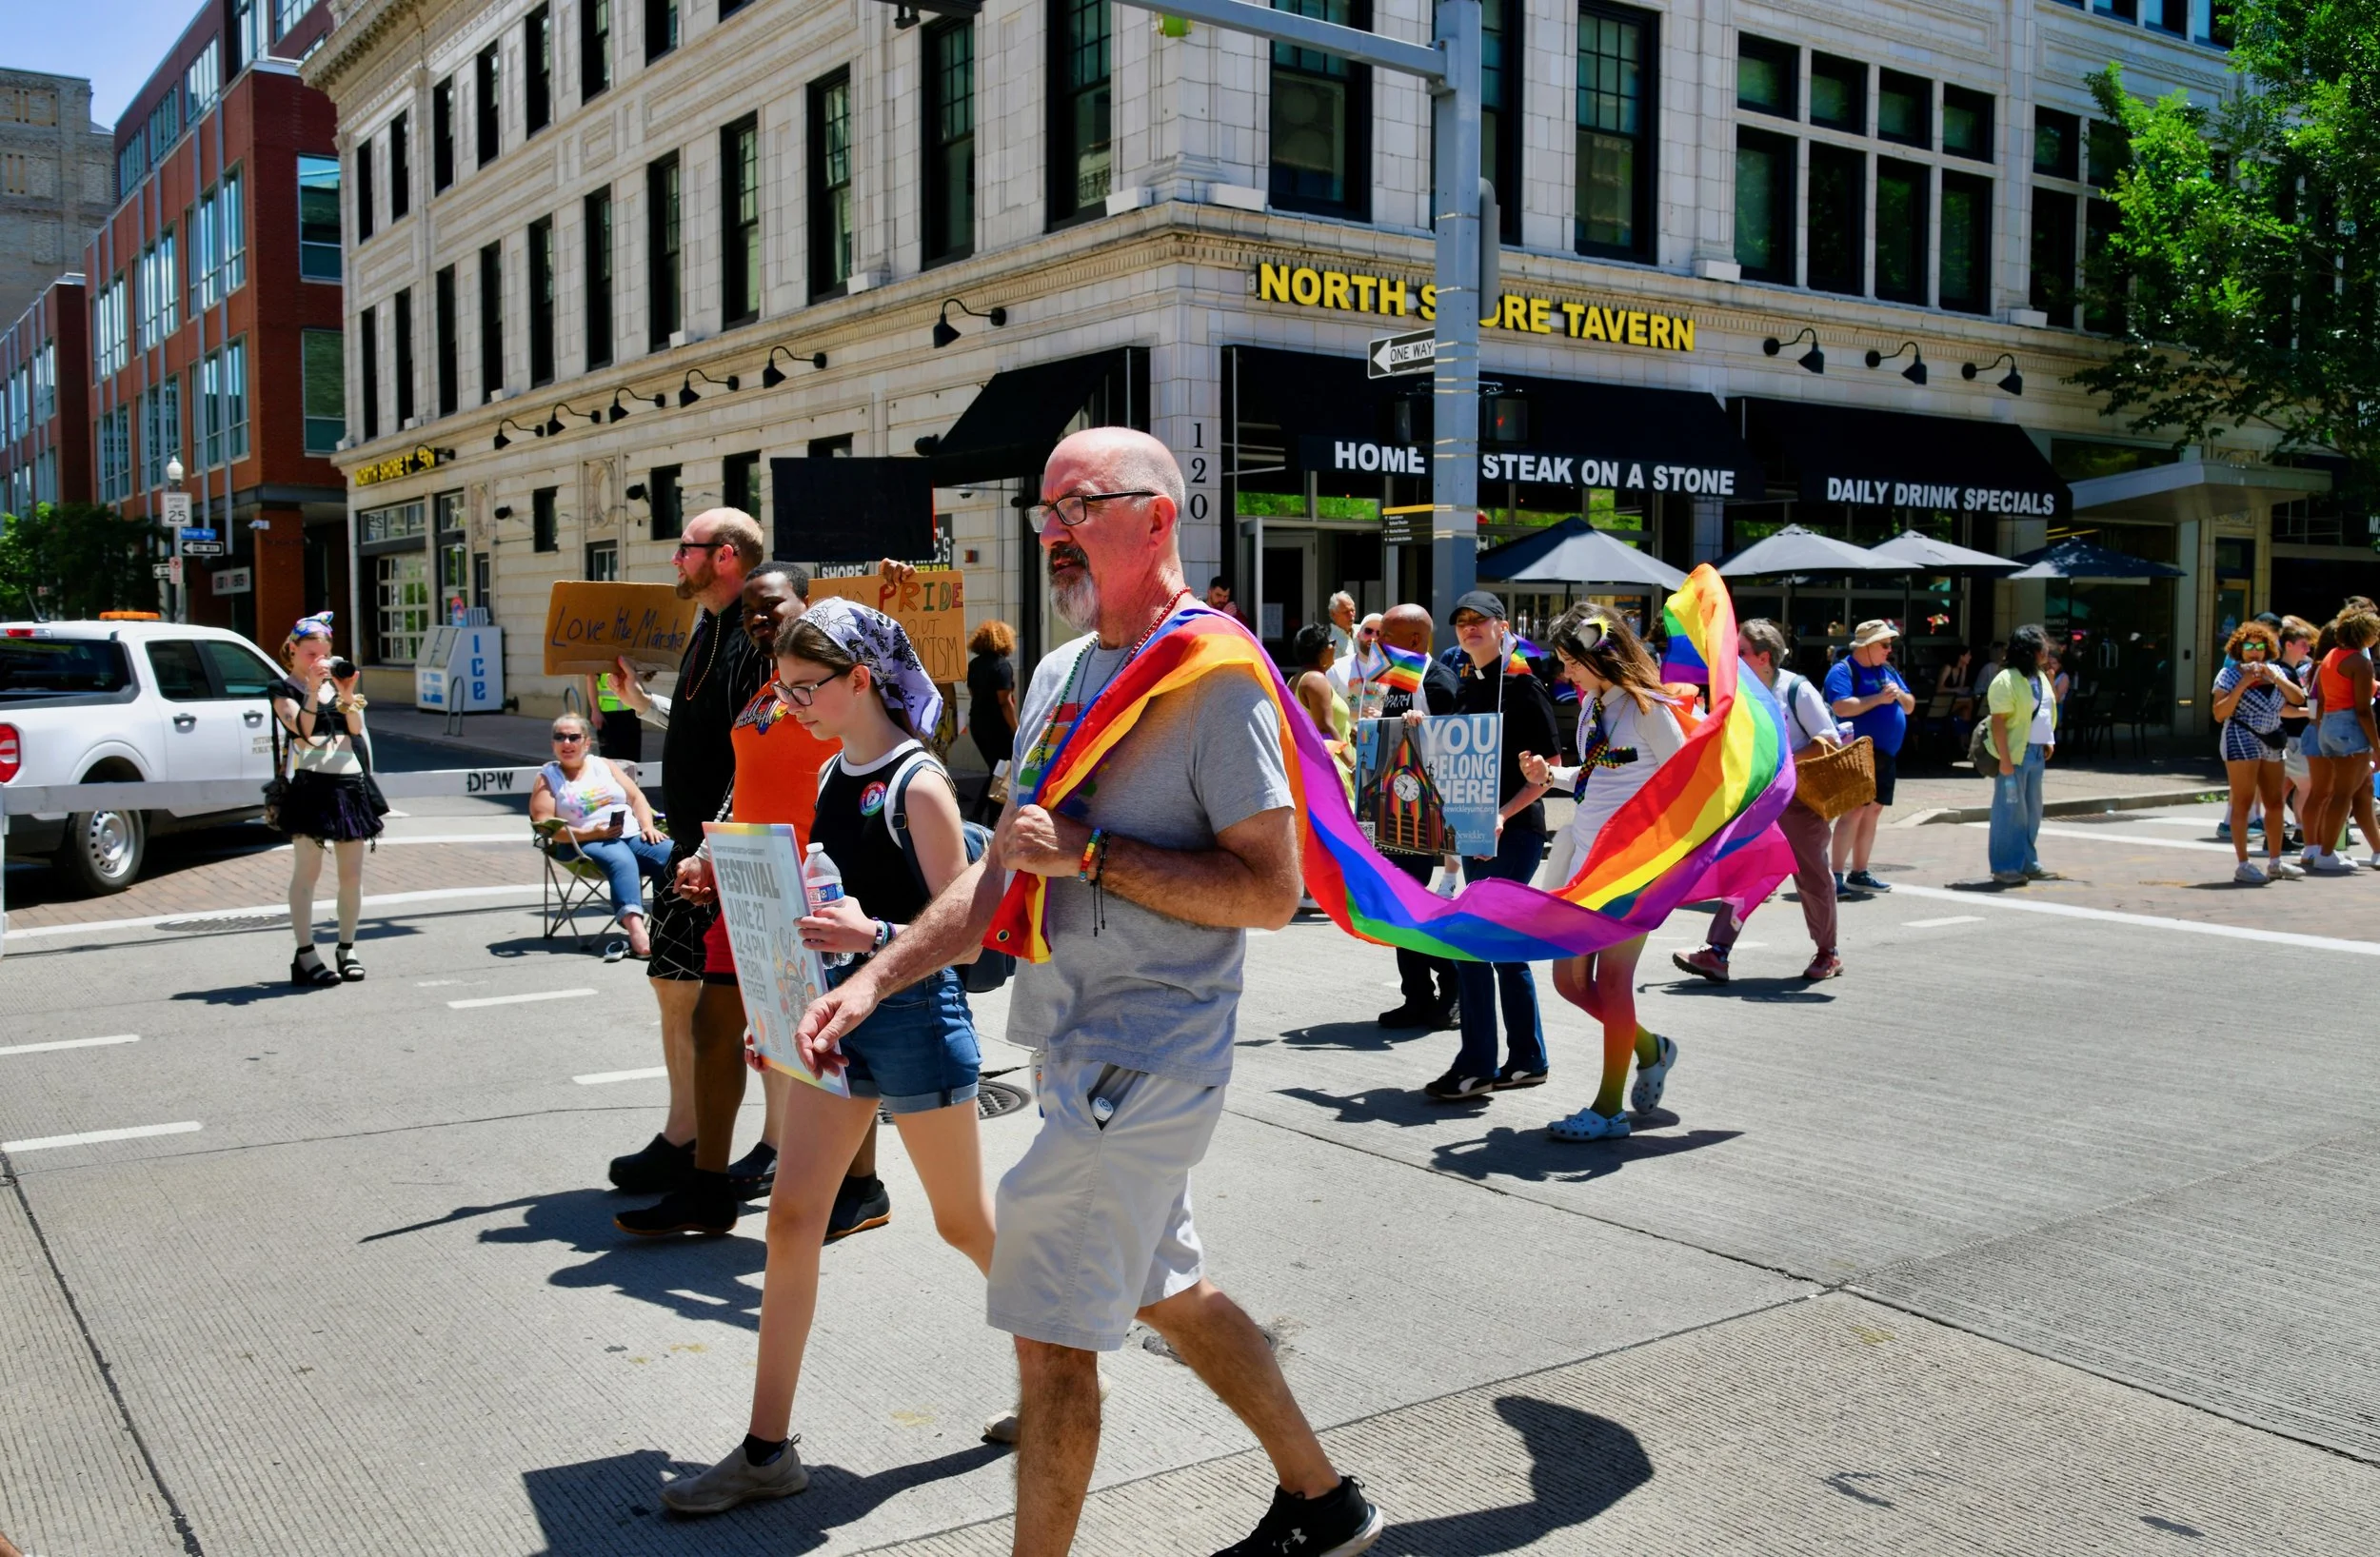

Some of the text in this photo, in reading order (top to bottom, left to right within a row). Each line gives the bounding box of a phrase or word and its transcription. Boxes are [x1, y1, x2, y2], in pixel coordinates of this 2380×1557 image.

[1259, 263, 1696, 351] NORTH SRE TAVERN
[1390, 341, 1435, 363] ONE WAY
[1190, 423, 1208, 520] 120
[1335, 441, 1735, 495] HOME STEAK ON A STONE
[1827, 477, 2054, 516] DAILY DRINK SPECIALS
[168, 510, 187, 522] 25
[879, 580, 963, 613] PRIDE
[551, 606, 605, 647] Love
[1421, 717, 1497, 755] YOU
[466, 772, 514, 792] DPW
[1428, 754, 1496, 779] BELONG
[1435, 779, 1495, 804] HERE
[716, 858, 781, 899] FESTIVAL
[727, 897, 767, 933] JUNE 27
[743, 977, 768, 1004] STREET
